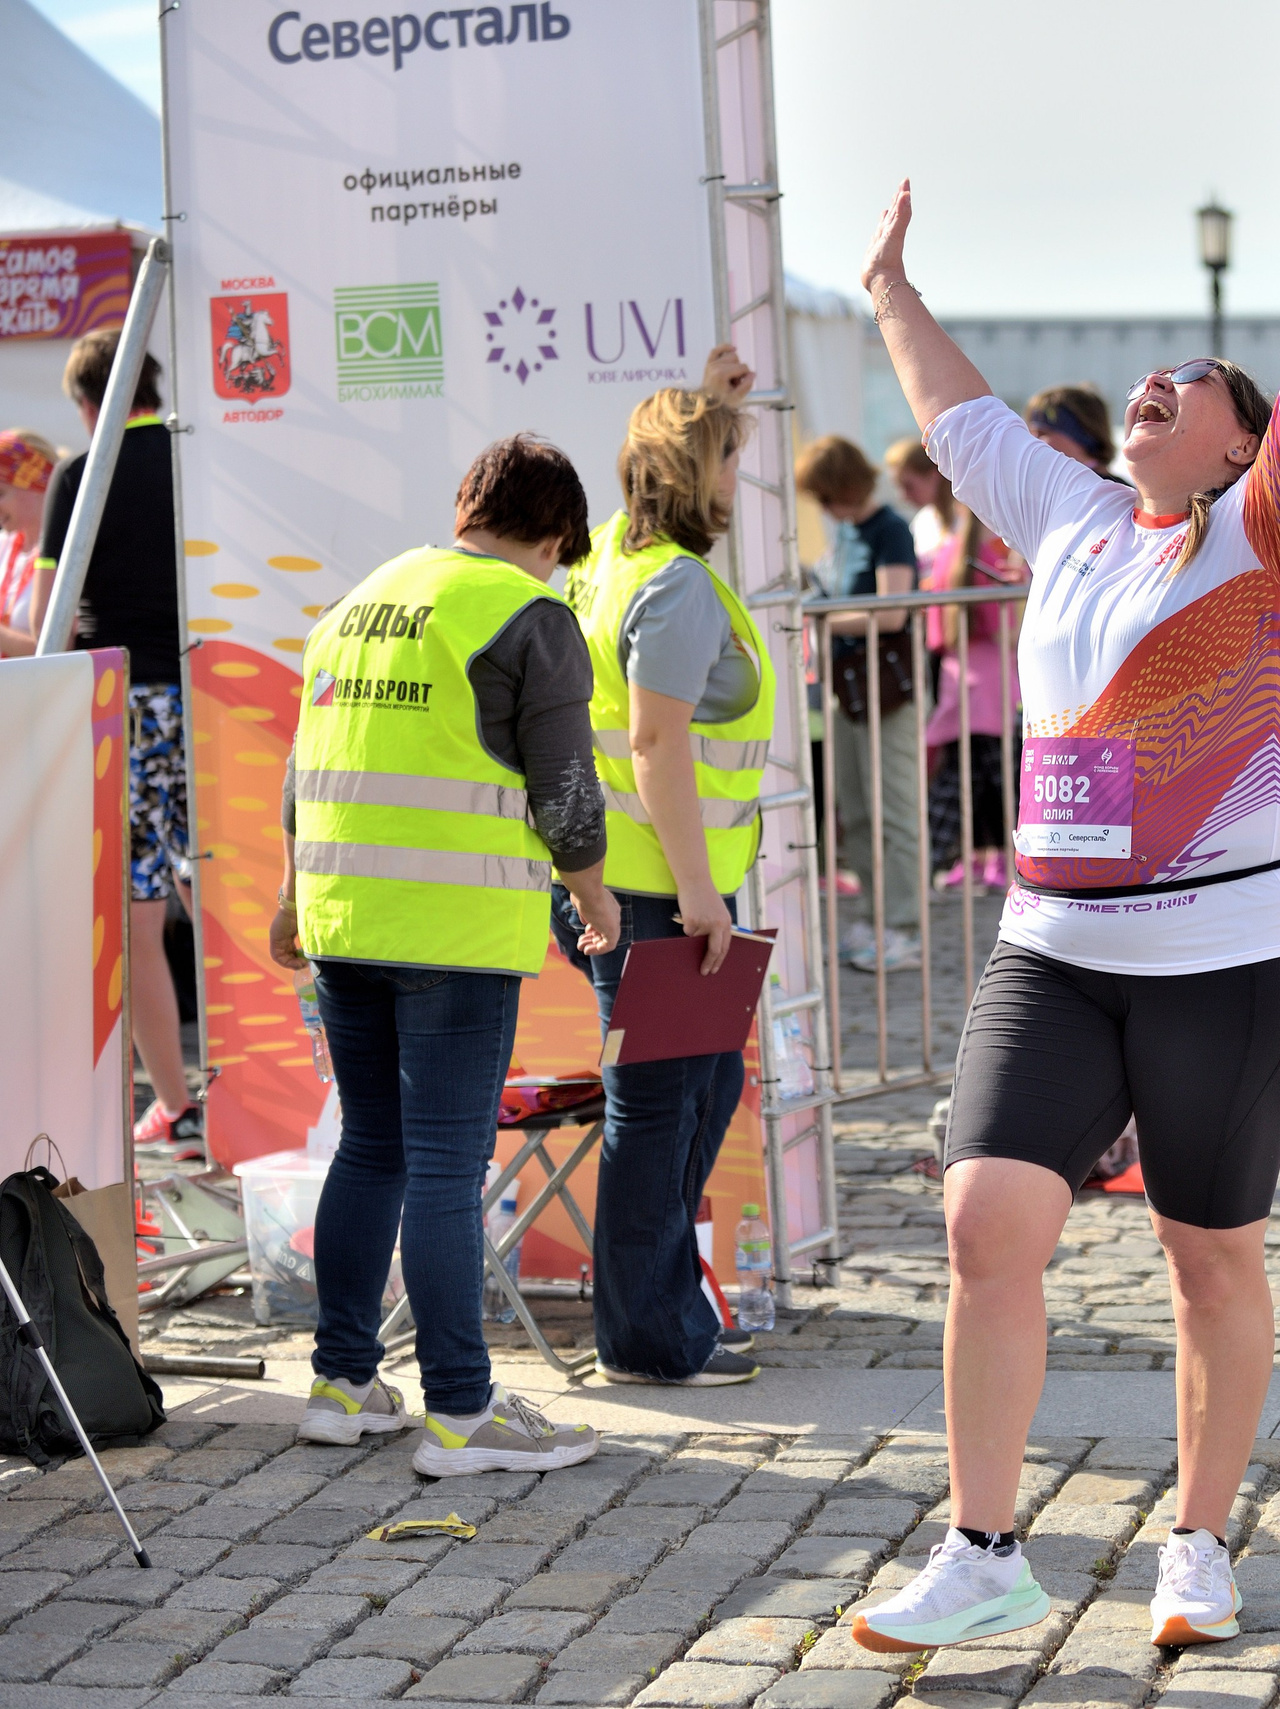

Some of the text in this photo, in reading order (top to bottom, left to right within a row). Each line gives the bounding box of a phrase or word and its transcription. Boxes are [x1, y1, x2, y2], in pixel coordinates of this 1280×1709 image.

[267, 1, 571, 71] Северсталь
[343, 161, 521, 194] официальные
[371, 195, 498, 225] партнёры
[221, 276, 276, 291] МОСКВА
[584, 298, 686, 364] UVI
[587, 368, 687, 384] ЮВЕЛИРОЧКА
[338, 383, 445, 402] БИОХИММАК
[222, 409, 284, 423] АВТОДОР
[339, 603, 435, 643] СУДЬЯ
[1034, 775, 1091, 803] 5082
[1043, 809, 1073, 820] ЮЛИЯ
[1069, 834, 1106, 842] Северсталь
[1123, 903, 1152, 913] TO
